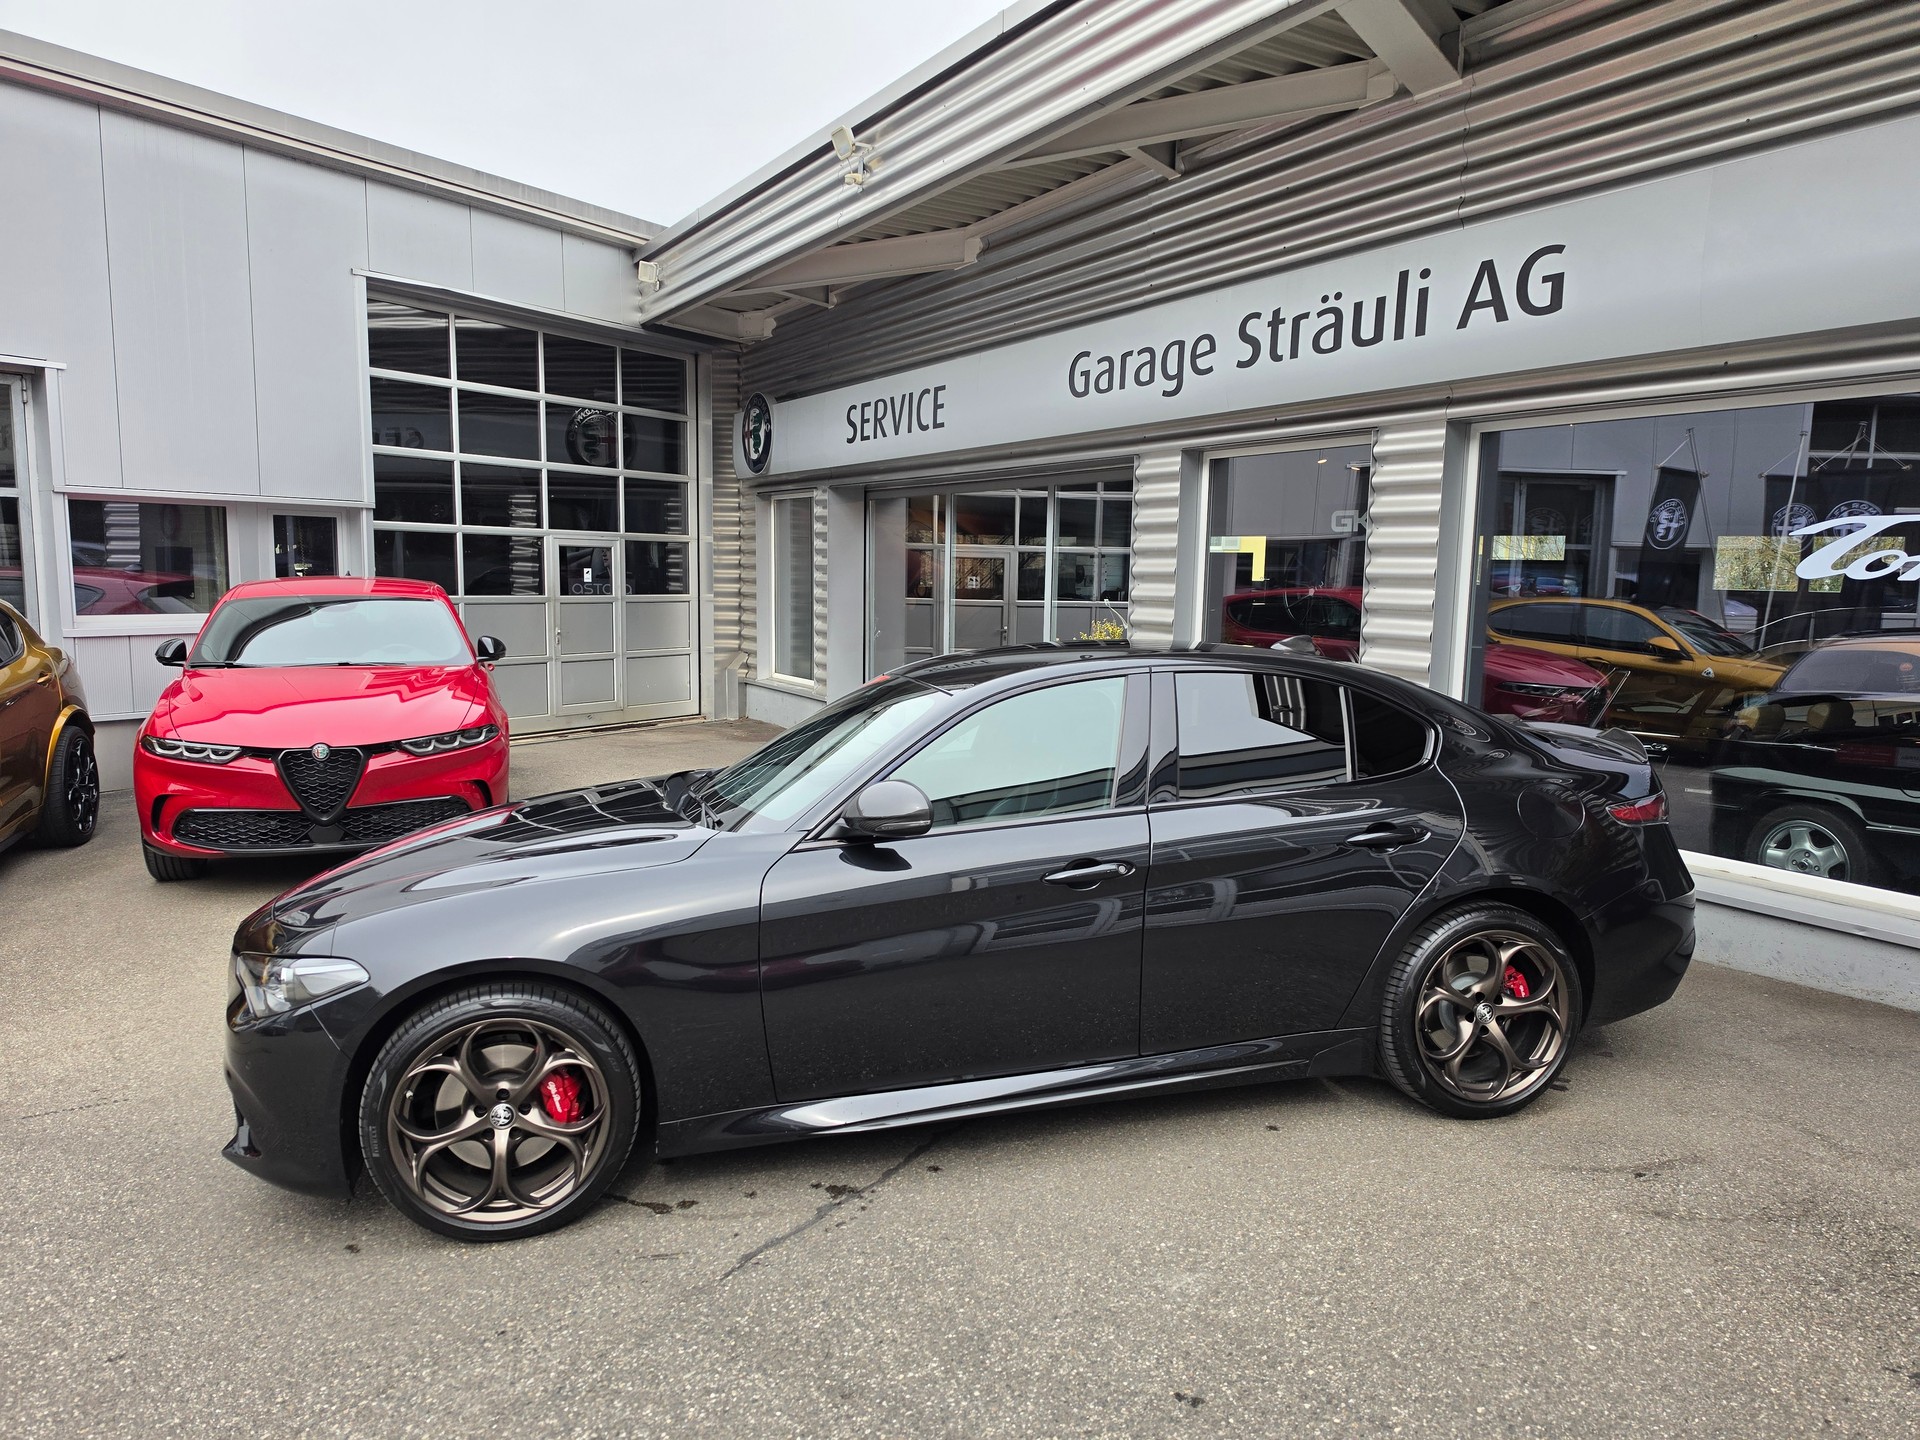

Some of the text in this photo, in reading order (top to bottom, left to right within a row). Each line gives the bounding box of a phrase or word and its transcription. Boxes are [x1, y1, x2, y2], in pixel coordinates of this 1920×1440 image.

[1068, 244, 1567, 398] Garage Sträuli AG
[846, 384, 947, 444] SERVICE
